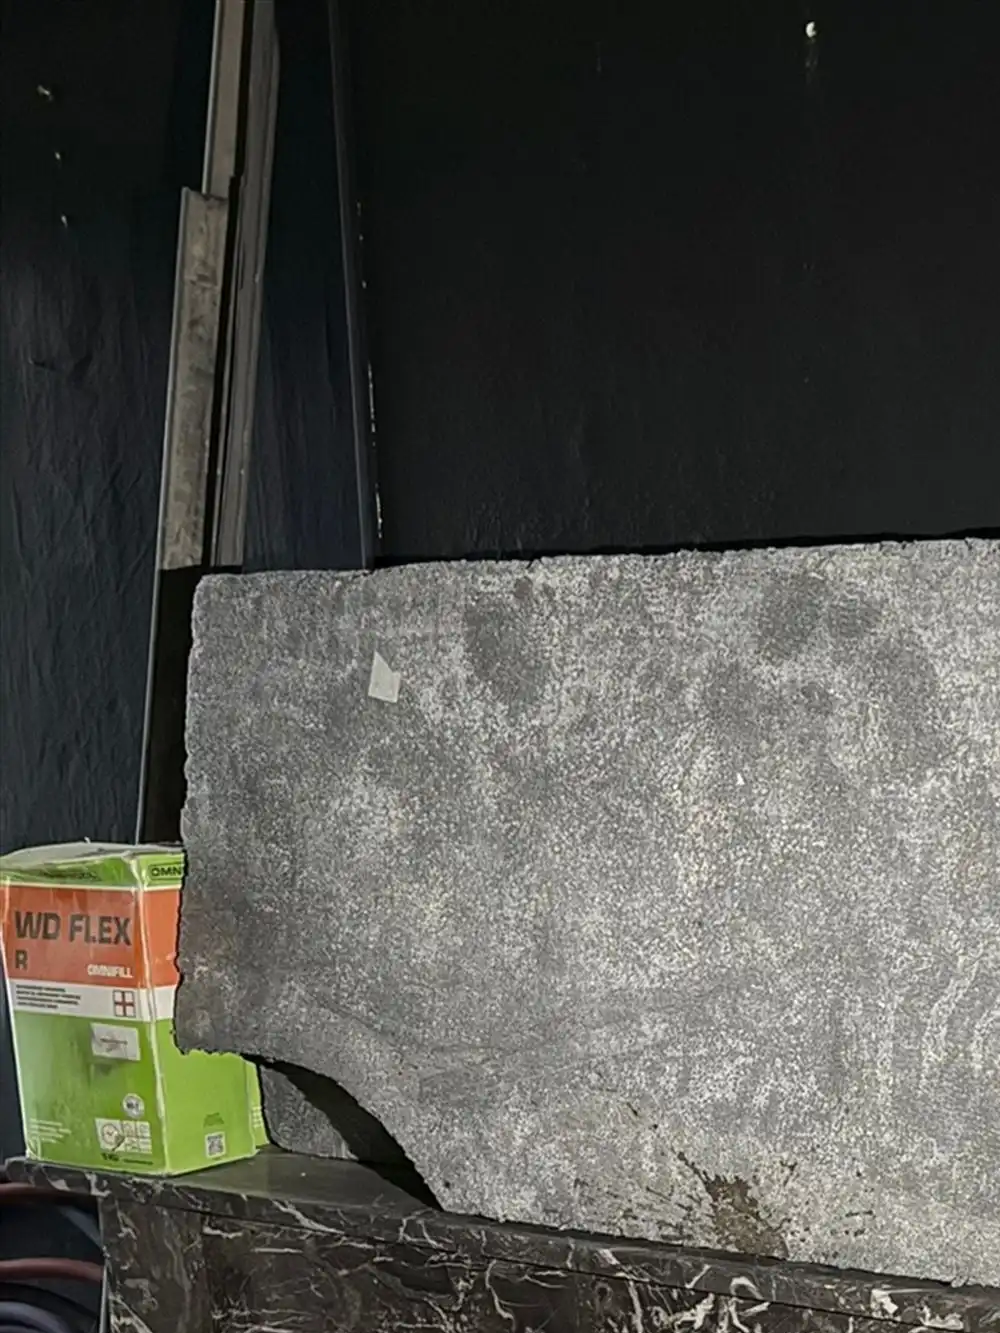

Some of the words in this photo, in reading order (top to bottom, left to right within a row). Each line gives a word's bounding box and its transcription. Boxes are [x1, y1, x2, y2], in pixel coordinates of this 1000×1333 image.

[15, 911, 61, 940] WD
[69, 914, 132, 946] FLEX
[15, 950, 28, 969] R
